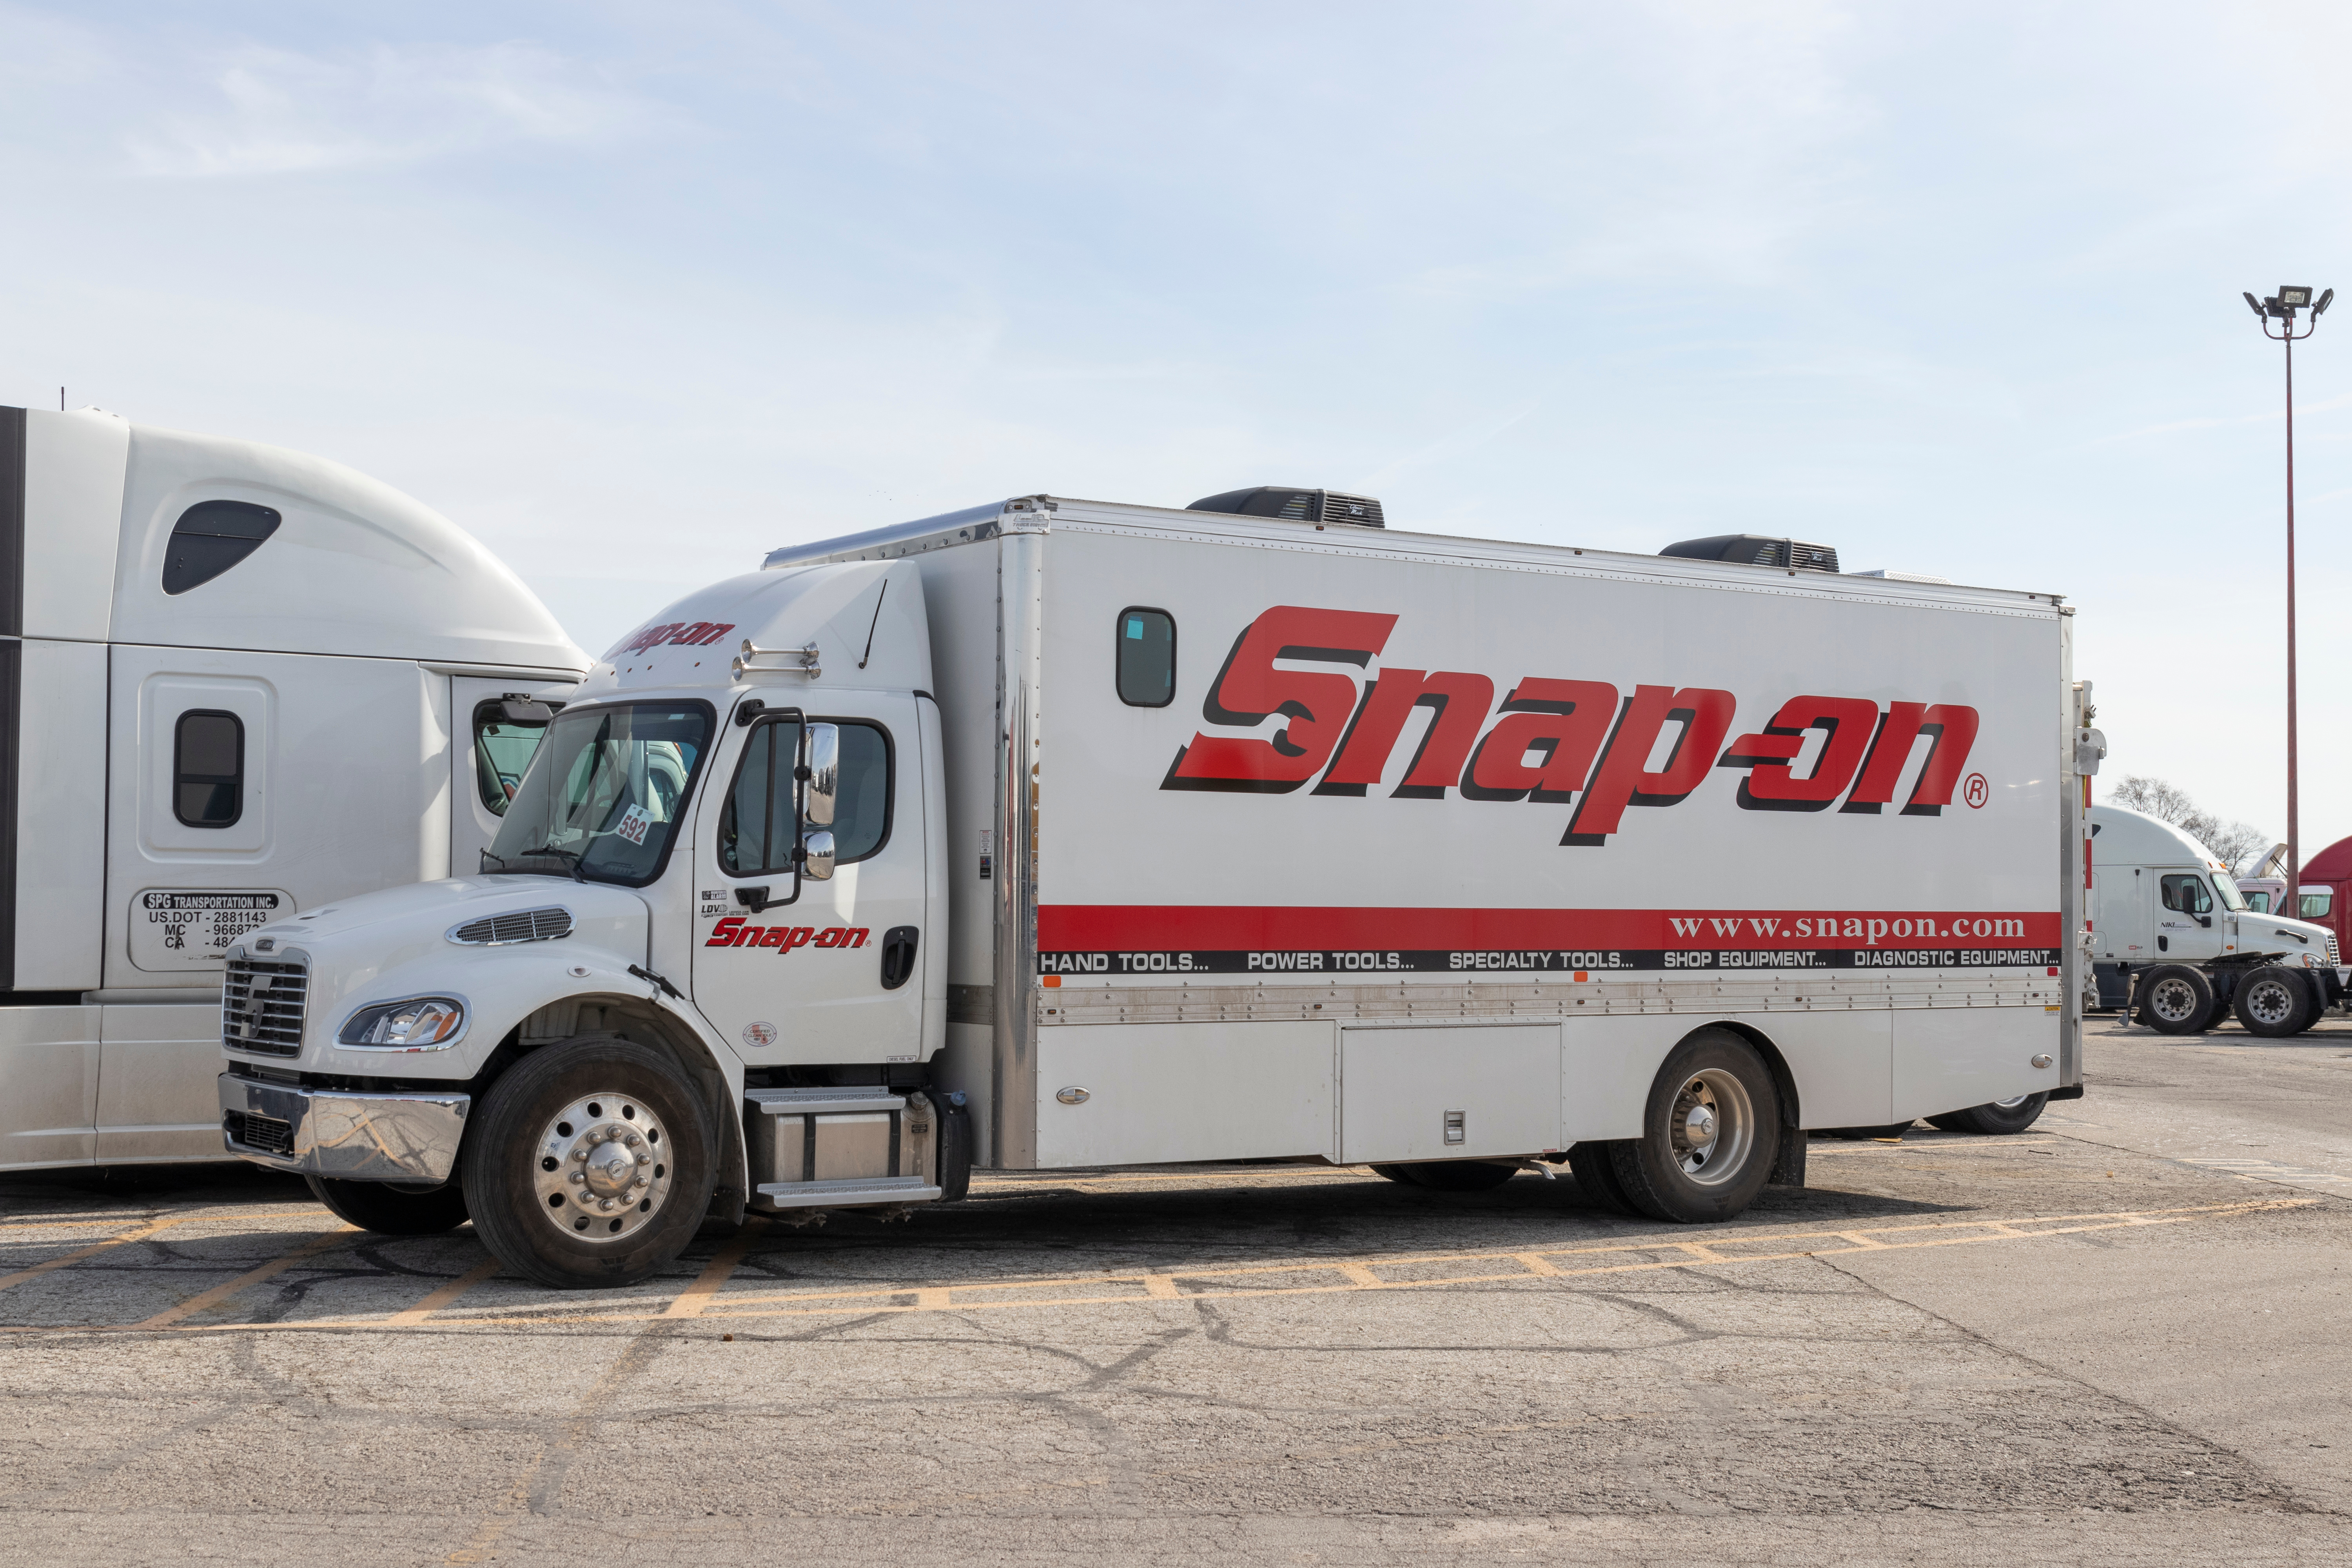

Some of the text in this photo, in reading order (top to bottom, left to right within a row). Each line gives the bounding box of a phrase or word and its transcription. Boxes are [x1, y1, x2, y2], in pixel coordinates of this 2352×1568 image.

[604, 622, 735, 662] nap-on
[1159, 605, 1980, 846] Snap-on
[619, 814, 646, 843] 592
[148, 894, 274, 908] SPG TRANSPORTATION INC.
[701, 905, 720, 913] LDV
[149, 911, 202, 923] US.DOT
[214, 912, 266, 923] 2881143
[165, 924, 186, 935] MC
[704, 917, 869, 955] Snap-on
[1669, 918, 2025, 945] www.snapon.com
[165, 937, 185, 948] CA
[1041, 953, 1209, 971] HAND TOOLS...
[1248, 953, 1414, 969] POWER TOOLS...
[1450, 952, 1633, 969] SPECIALTY TOOLS...
[1664, 951, 1826, 967] SHOP EQUIPMENT...
[1855, 950, 2058, 965] DIAGNOSTIC EQUIPMENT...
